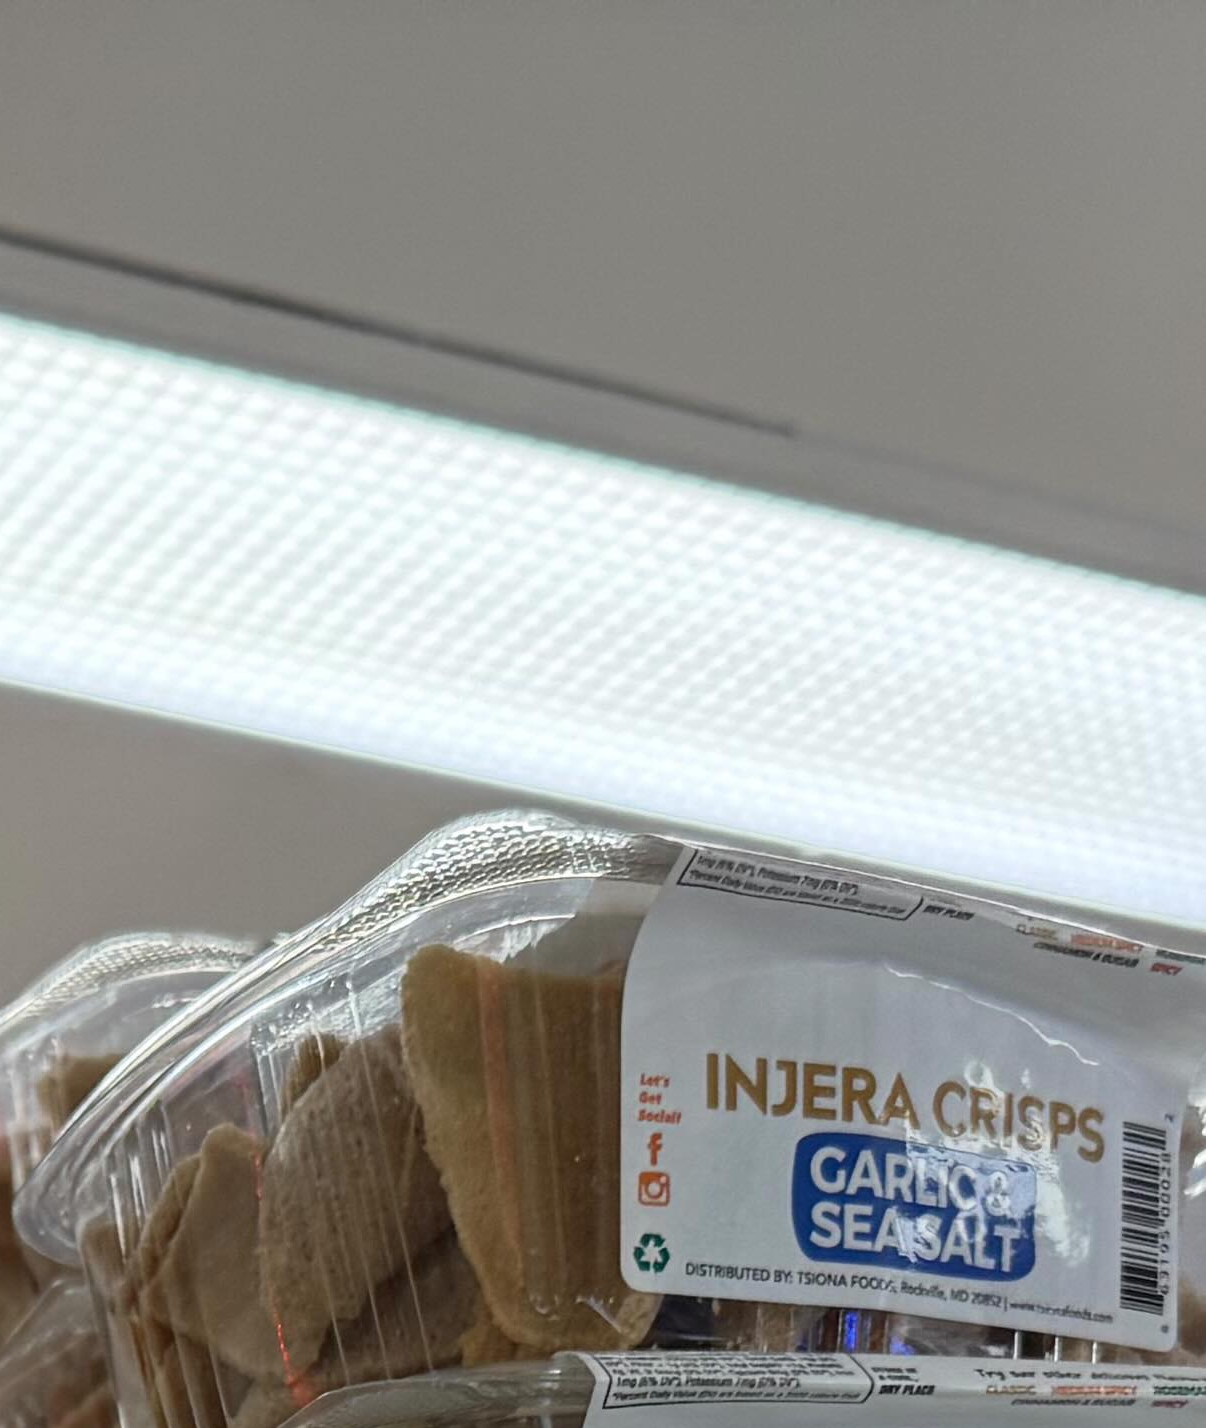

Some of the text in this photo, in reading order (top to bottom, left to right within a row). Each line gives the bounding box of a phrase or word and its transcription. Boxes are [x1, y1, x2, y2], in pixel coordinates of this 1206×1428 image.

[706, 1053, 1105, 1163] INJERA CRISPS
[810, 1146, 1011, 1217] GARLIC &
[809, 1201, 1023, 1273] SEA SALT
[684, 1262, 770, 1283] DISTRIBUTED
[796, 1270, 848, 1289] TSIONA
